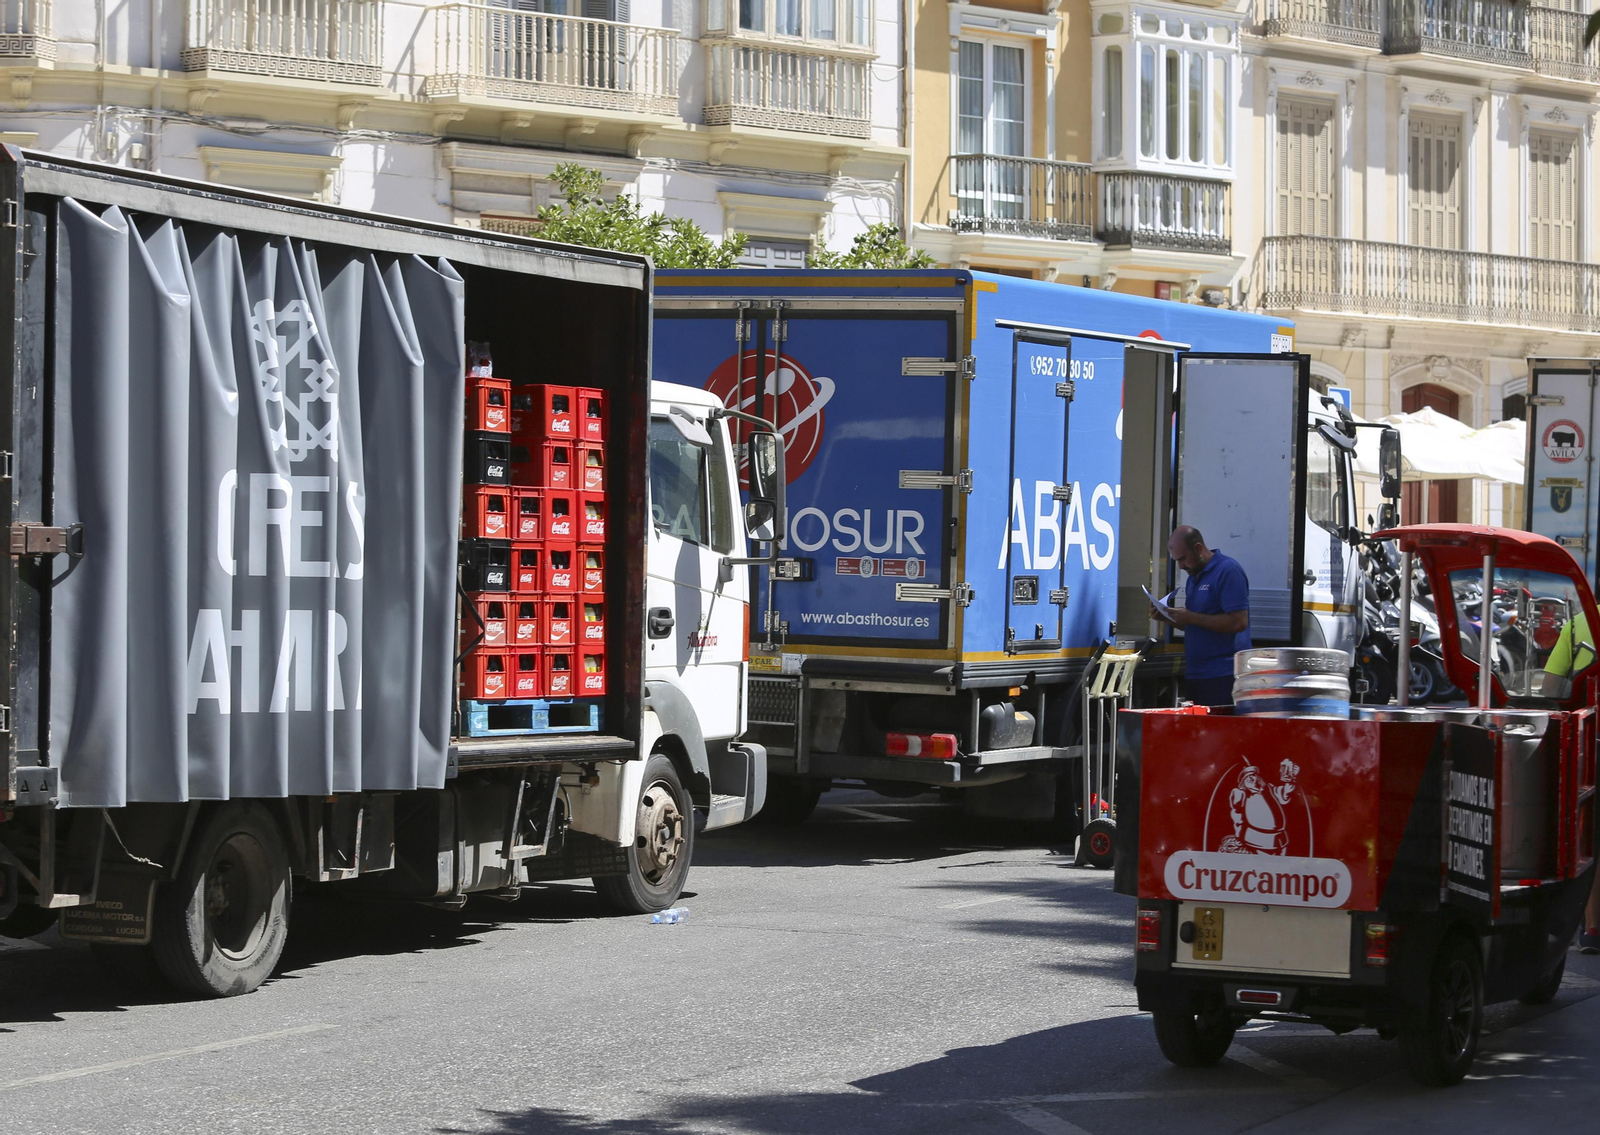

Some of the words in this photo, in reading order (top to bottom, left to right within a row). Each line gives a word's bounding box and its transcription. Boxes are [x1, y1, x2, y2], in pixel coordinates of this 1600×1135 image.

[1036, 355, 1053, 377] 952
[1056, 357, 1067, 378] 70
[1069, 359, 1081, 379] 30
[1082, 360, 1095, 381] 50
[998, 477, 1121, 571] ABAS
[801, 611, 930, 628] www.abasthosur.es
[1178, 859, 1338, 902] Cruzcampo
[96, 901, 123, 910] IVECO
[66, 910, 102, 920] LUCENA
[102, 912, 135, 922] MOTOR
[115, 927, 145, 936] LUCENA
